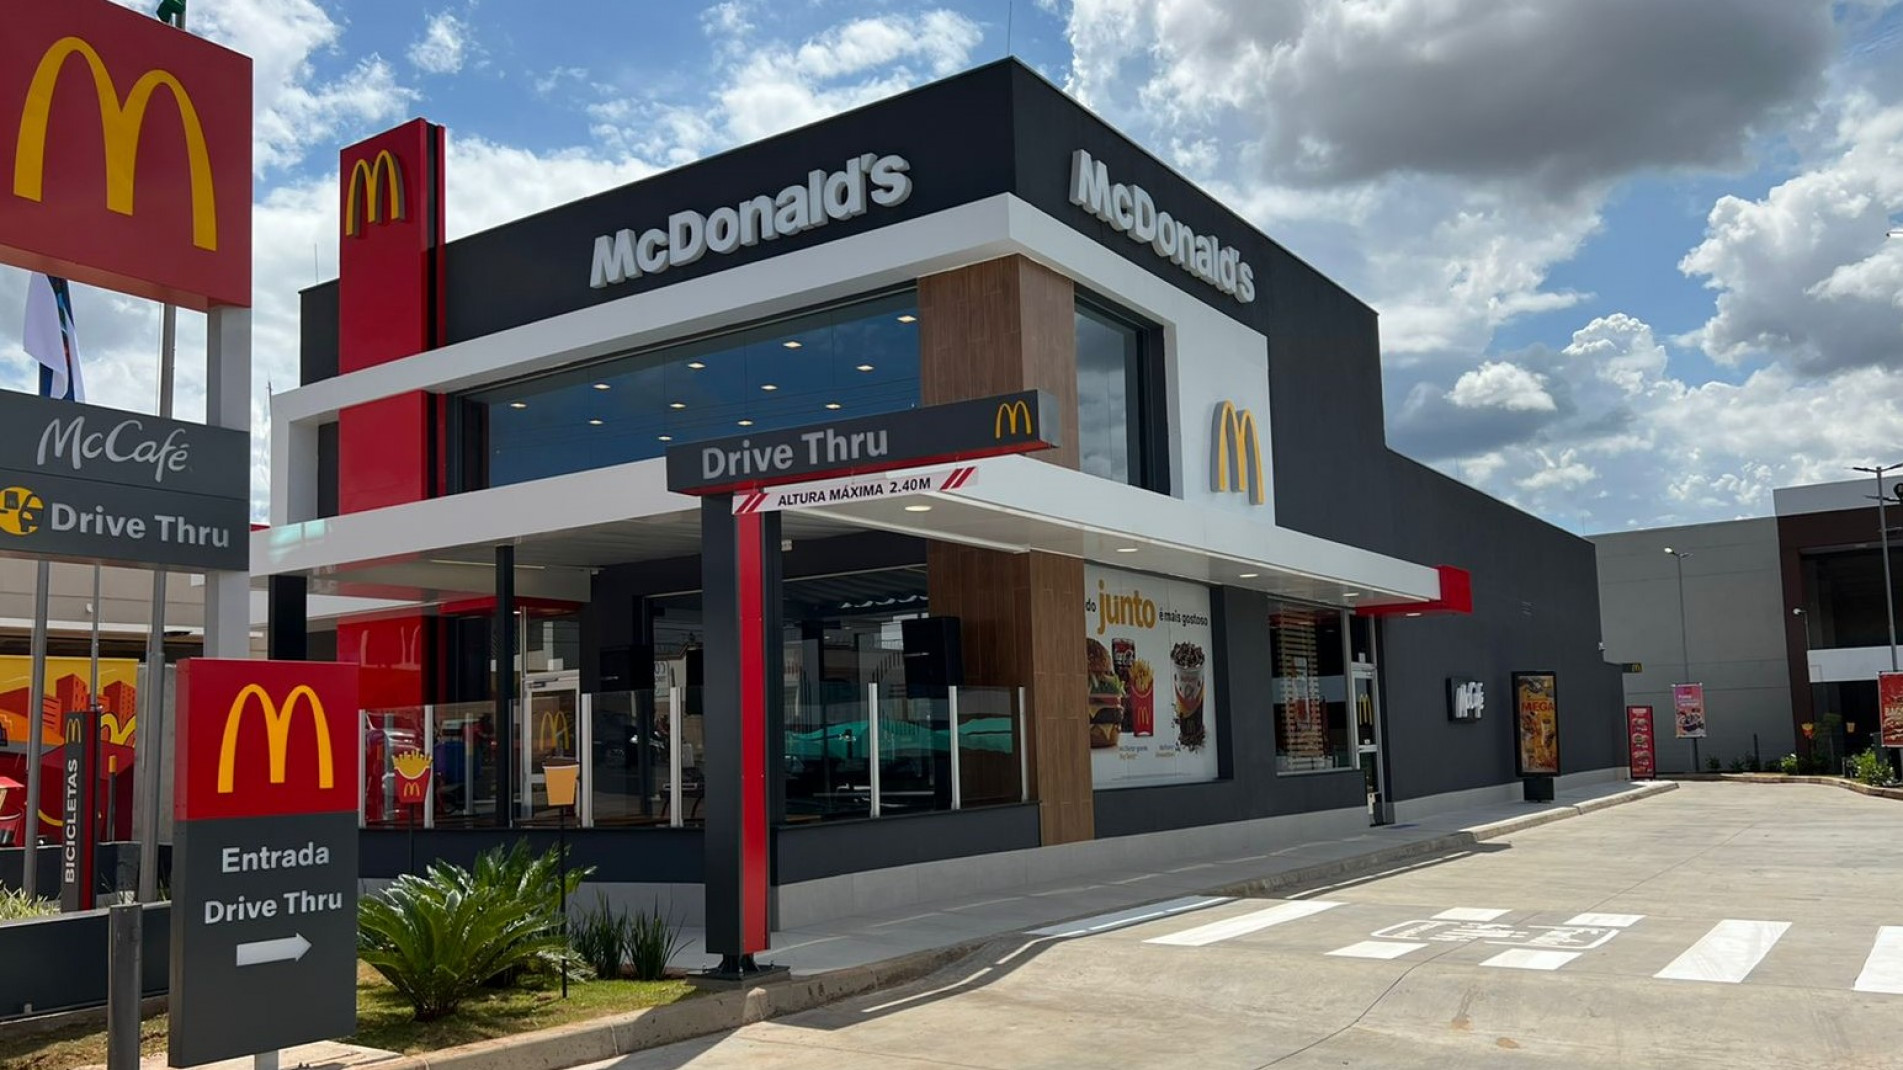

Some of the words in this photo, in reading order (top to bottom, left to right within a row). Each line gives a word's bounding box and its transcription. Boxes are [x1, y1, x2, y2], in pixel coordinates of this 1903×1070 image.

[590, 152, 912, 288] McDonald's
[1069, 149, 1255, 303] McDonald's
[37, 416, 190, 482] McCafé
[701, 439, 794, 480] Drive
[801, 427, 888, 465] Thru
[777, 491, 827, 508] ALTURA
[829, 484, 884, 500] MÁXIMA
[890, 477, 931, 493] 2.40M
[51, 502, 147, 540] Drive
[154, 514, 230, 548] Thru
[1097, 579, 1156, 634] junto
[1164, 609, 1181, 623] mais
[1181, 613, 1208, 627] gostoso
[64, 757, 79, 884] BICICLETAS
[221, 841, 330, 874] Entrada
[204, 893, 278, 925] Drive
[284, 889, 343, 914] Thru
